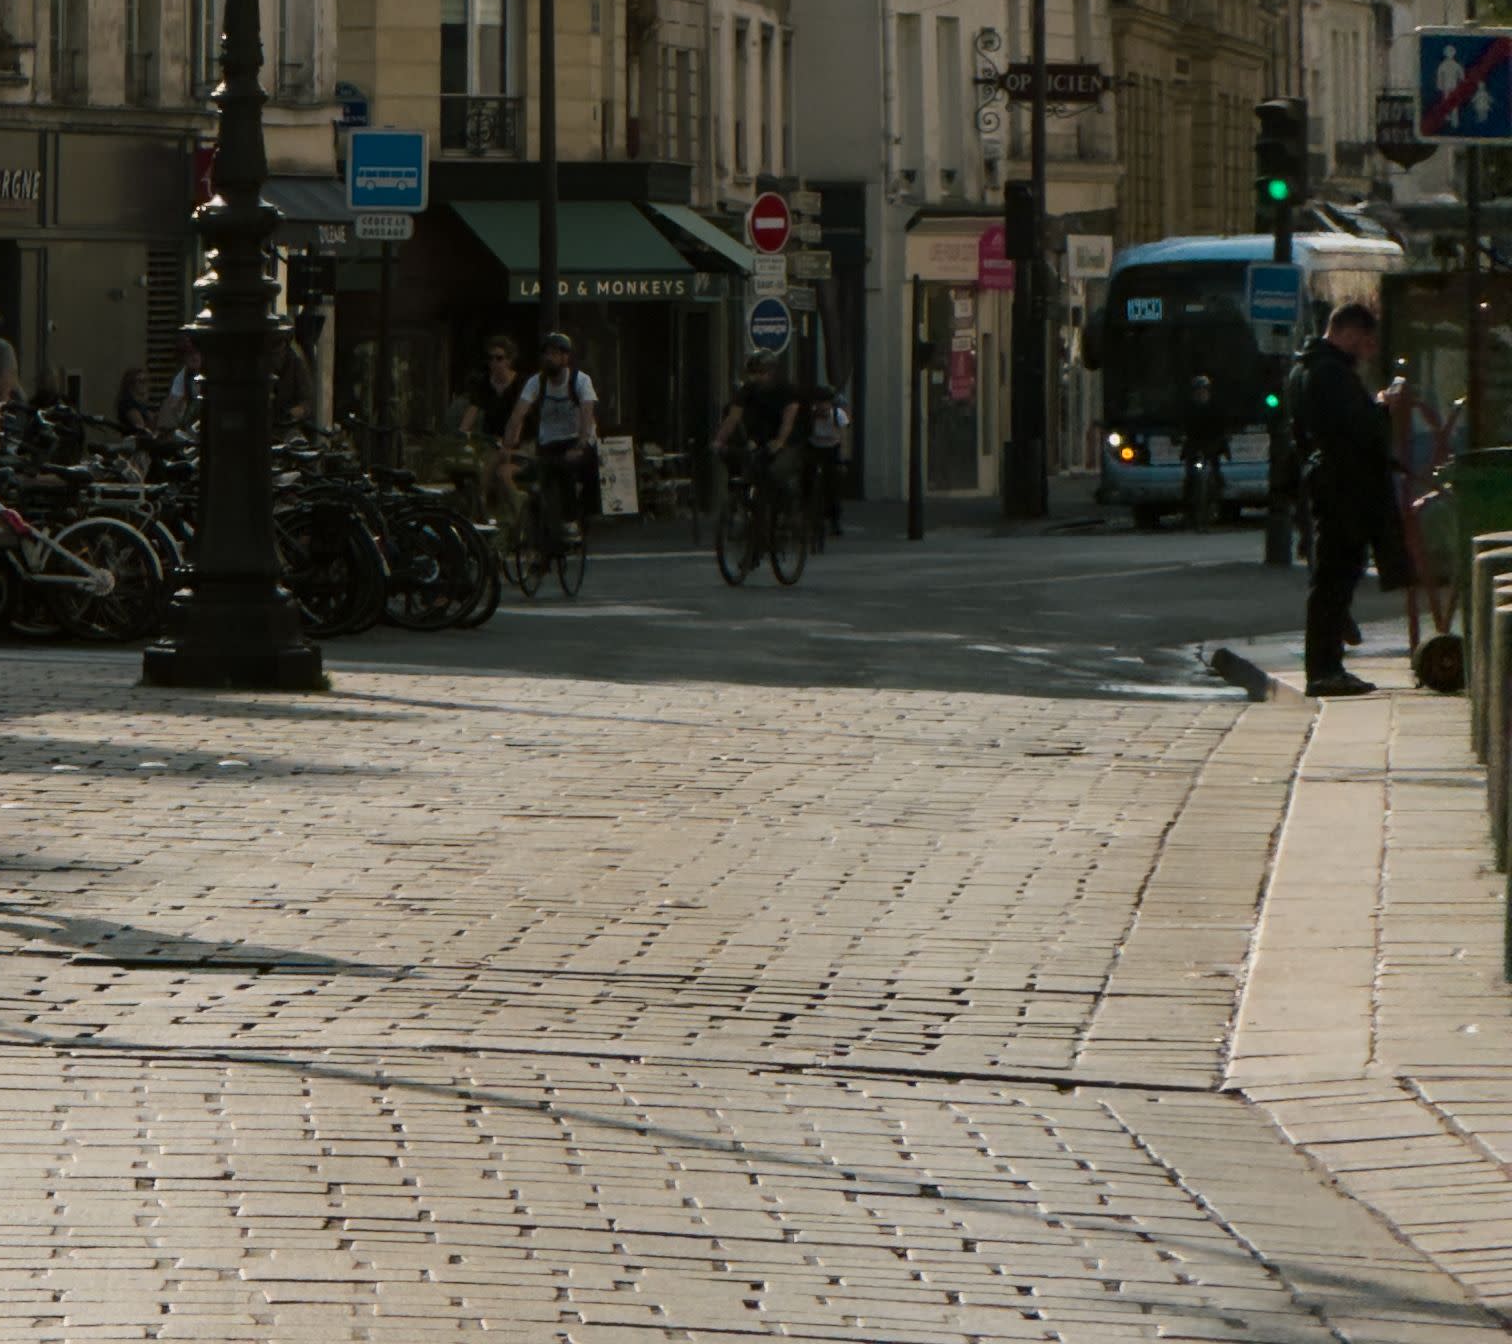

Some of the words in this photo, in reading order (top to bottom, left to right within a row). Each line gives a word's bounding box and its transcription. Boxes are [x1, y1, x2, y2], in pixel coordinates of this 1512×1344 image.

[1005, 73, 1104, 93] OPICIEN
[361, 228, 405, 237] PASSAGE
[520, 279, 569, 297] LAD
[576, 279, 589, 297] &
[596, 279, 686, 297] MONKEYS
